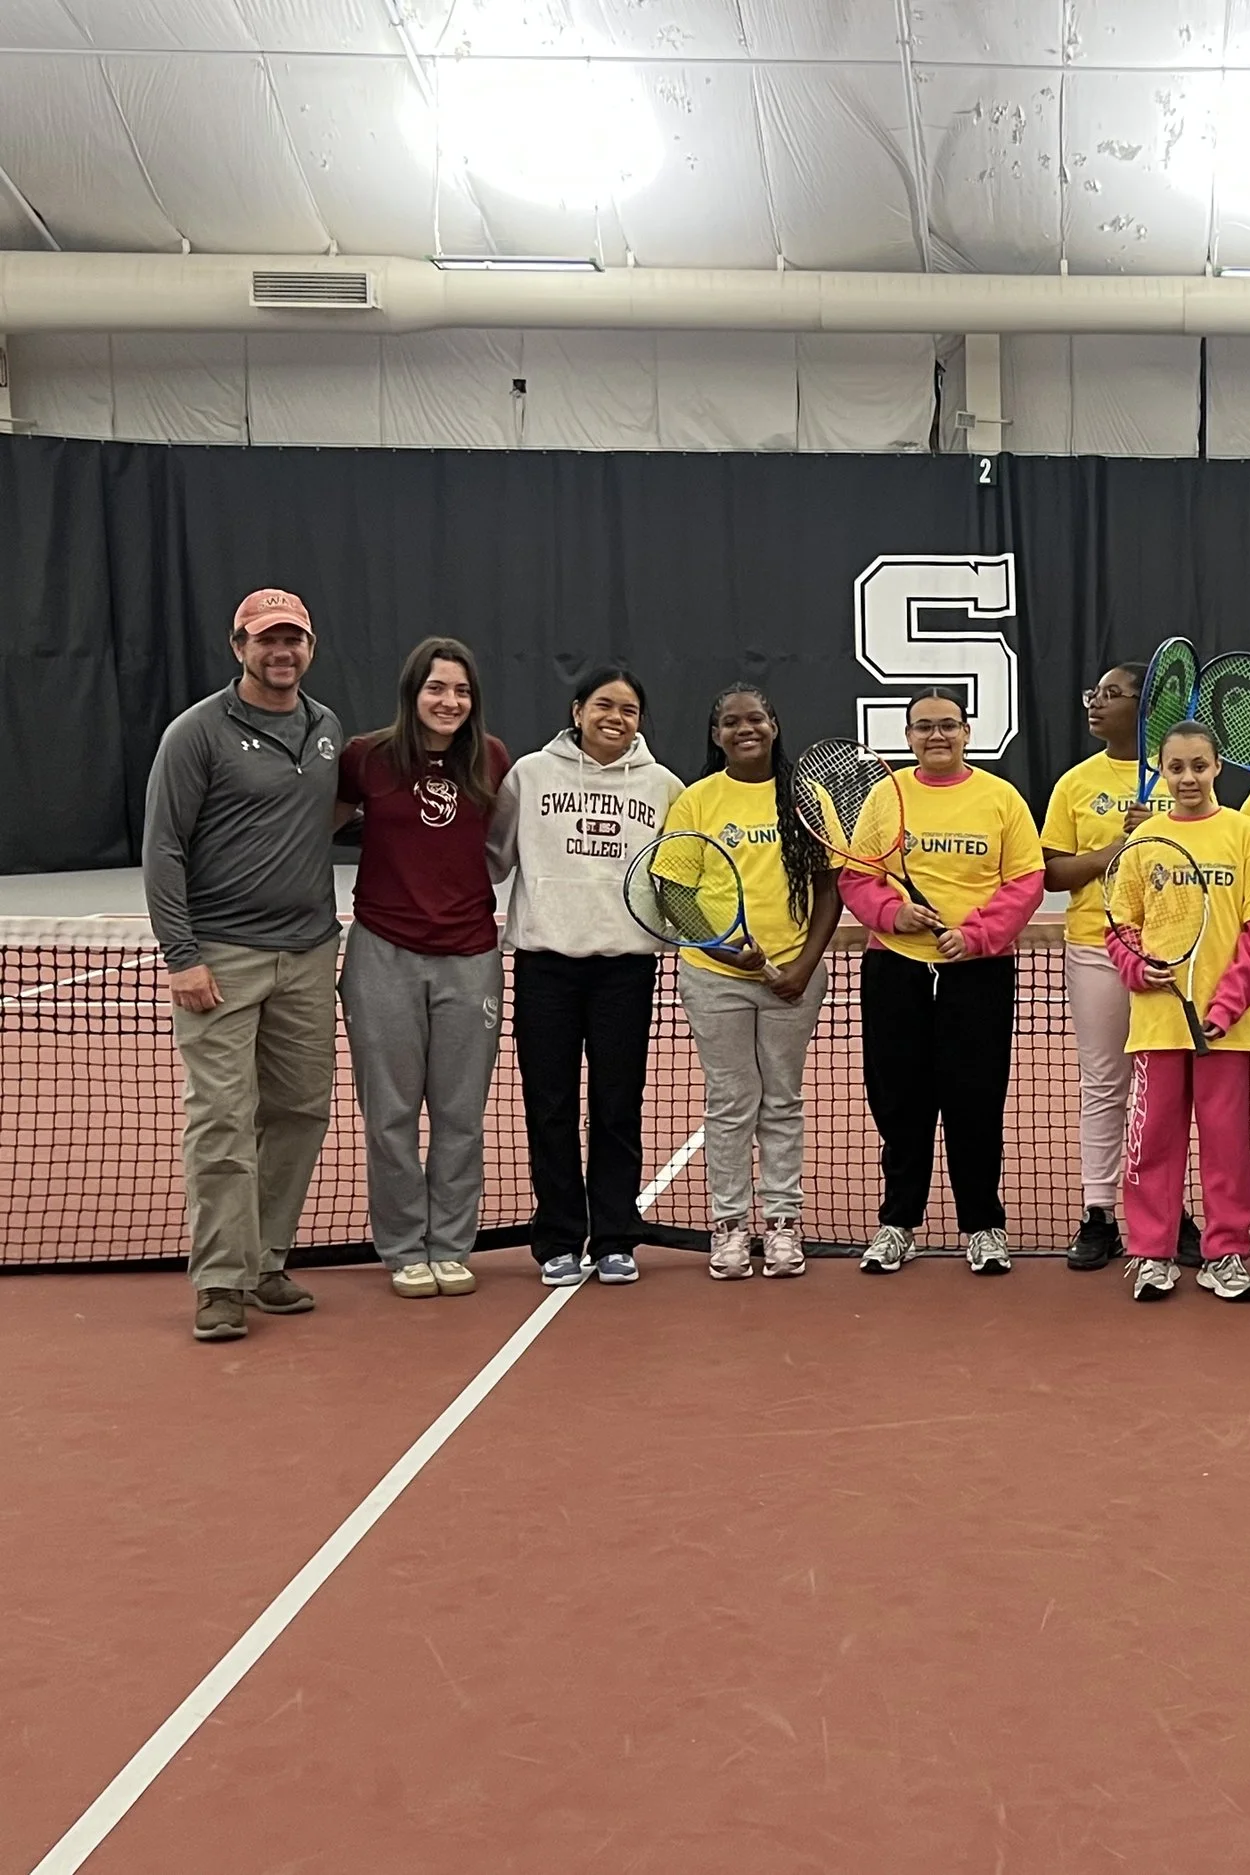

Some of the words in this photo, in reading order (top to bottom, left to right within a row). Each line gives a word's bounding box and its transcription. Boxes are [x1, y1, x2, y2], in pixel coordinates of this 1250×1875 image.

[979, 458, 992, 483] 2
[854, 553, 1018, 760] S
[541, 792, 656, 829] SWARTHMORE
[921, 838, 988, 856] UNITED
[1172, 870, 1234, 887] UNTED
